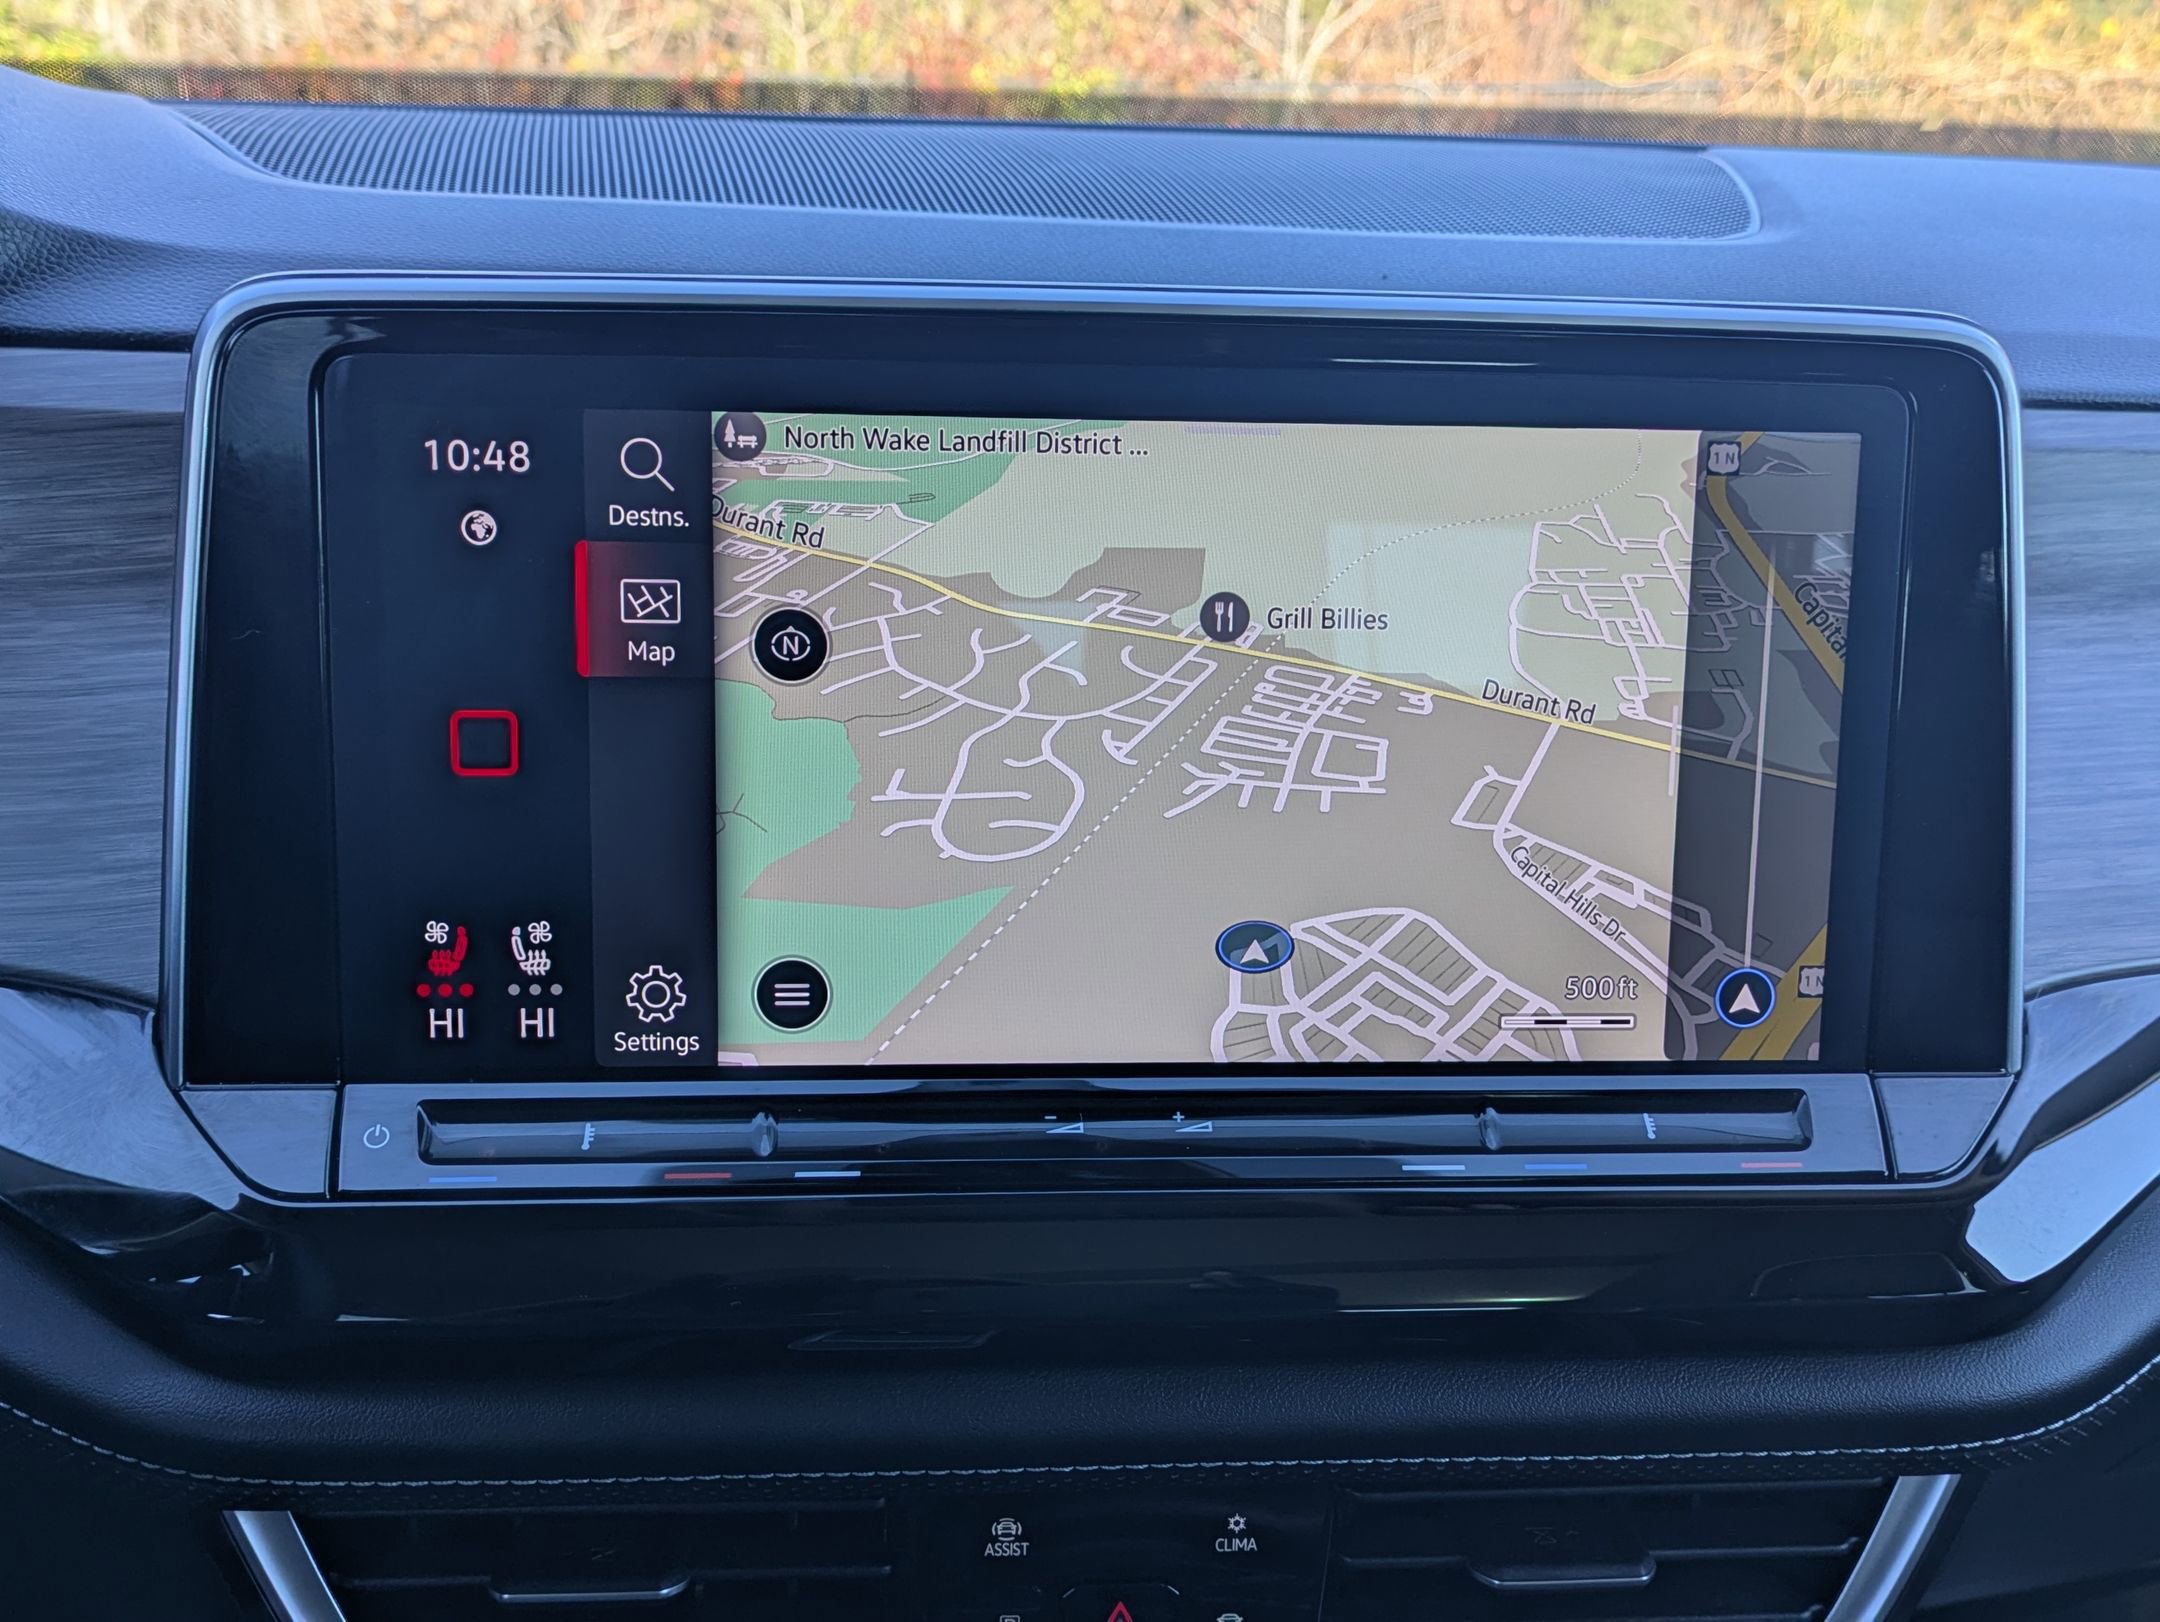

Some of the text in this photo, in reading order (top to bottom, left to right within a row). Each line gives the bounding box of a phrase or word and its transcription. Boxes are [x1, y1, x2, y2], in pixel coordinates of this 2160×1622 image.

[785, 427, 853, 450] North
[862, 429, 929, 453] Wake
[939, 428, 1027, 454] Landfill
[1036, 432, 1122, 456] District
[424, 439, 531, 472] 10:48
[1713, 453, 1735, 464] 1 N
[609, 504, 690, 527] Destns.
[792, 521, 825, 548] Rd
[1267, 608, 1388, 631] Grill Billies
[628, 641, 676, 666] Map
[782, 635, 798, 656] N
[1482, 679, 1596, 724] Durant Rd
[1510, 846, 1626, 942] Capital Hills Dr
[429, 1008, 464, 1038] HI
[520, 1007, 555, 1038] HI
[614, 1032, 700, 1056] Settings
[984, 1542, 1030, 1557] ASSIST
[1215, 1537, 1258, 1552] CLIMA
